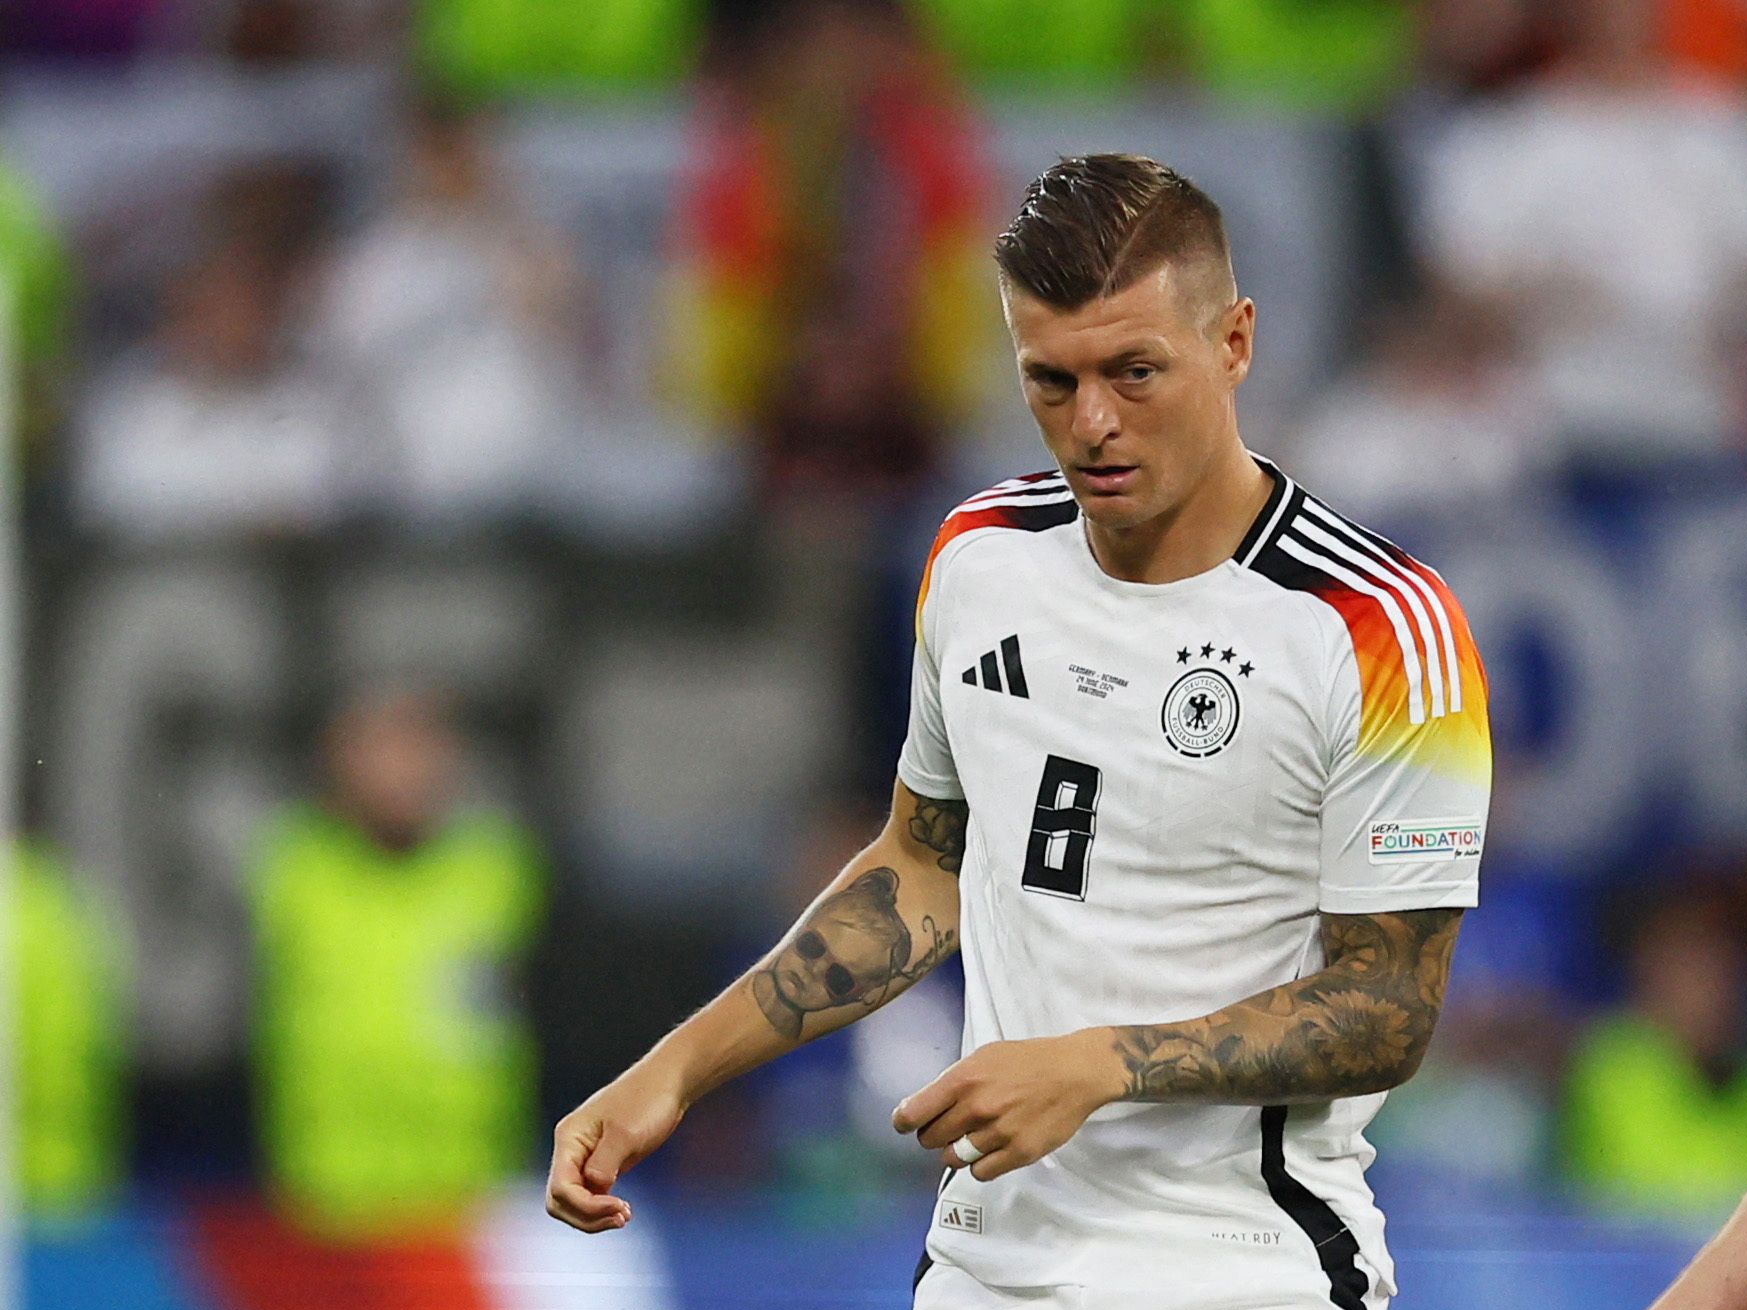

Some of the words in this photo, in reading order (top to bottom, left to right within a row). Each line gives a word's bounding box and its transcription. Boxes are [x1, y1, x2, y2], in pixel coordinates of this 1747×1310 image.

[1184, 679, 1226, 699] DEUTSCHER
[1021, 753, 1103, 903] 8
[1371, 823, 1400, 834] UEFA
[1371, 831, 1481, 850] FOUNDATION
